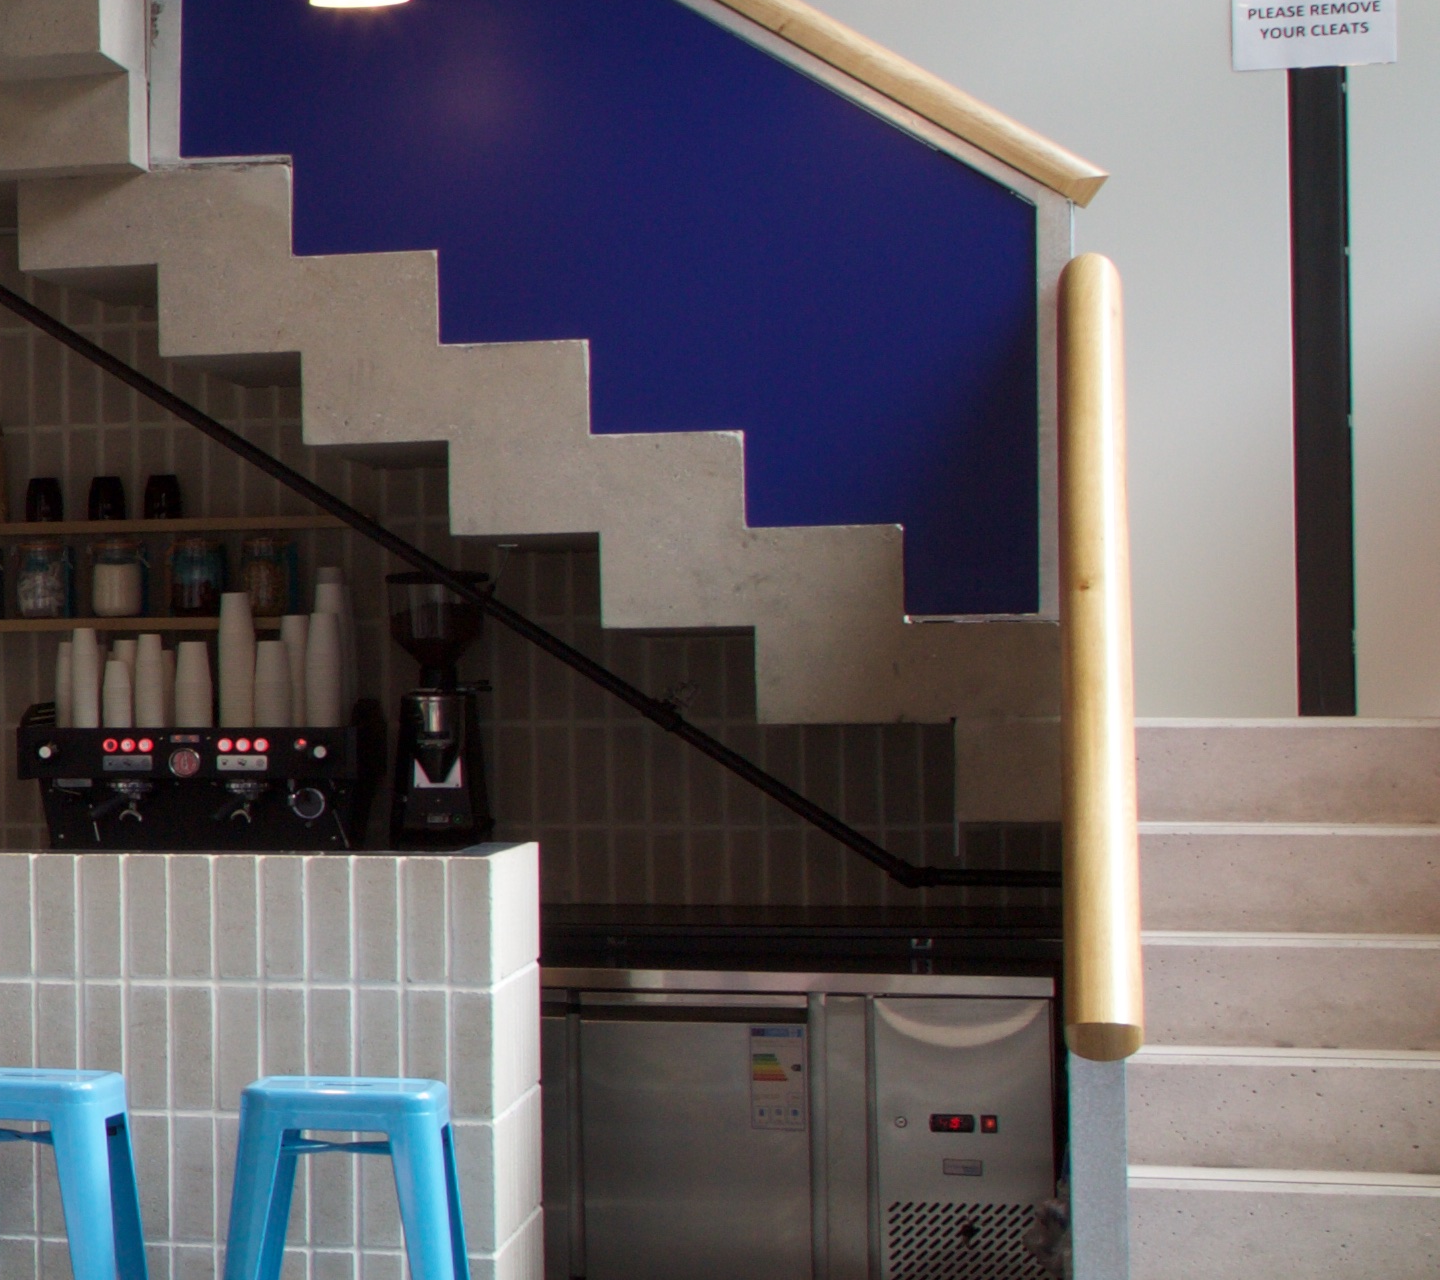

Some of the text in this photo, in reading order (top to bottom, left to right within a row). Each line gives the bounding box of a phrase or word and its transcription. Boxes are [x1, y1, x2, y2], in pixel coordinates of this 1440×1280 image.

[1247, 0, 1381, 20] PLEASE REMOVE
[1260, 21, 1369, 40] YOUR CLEATS
